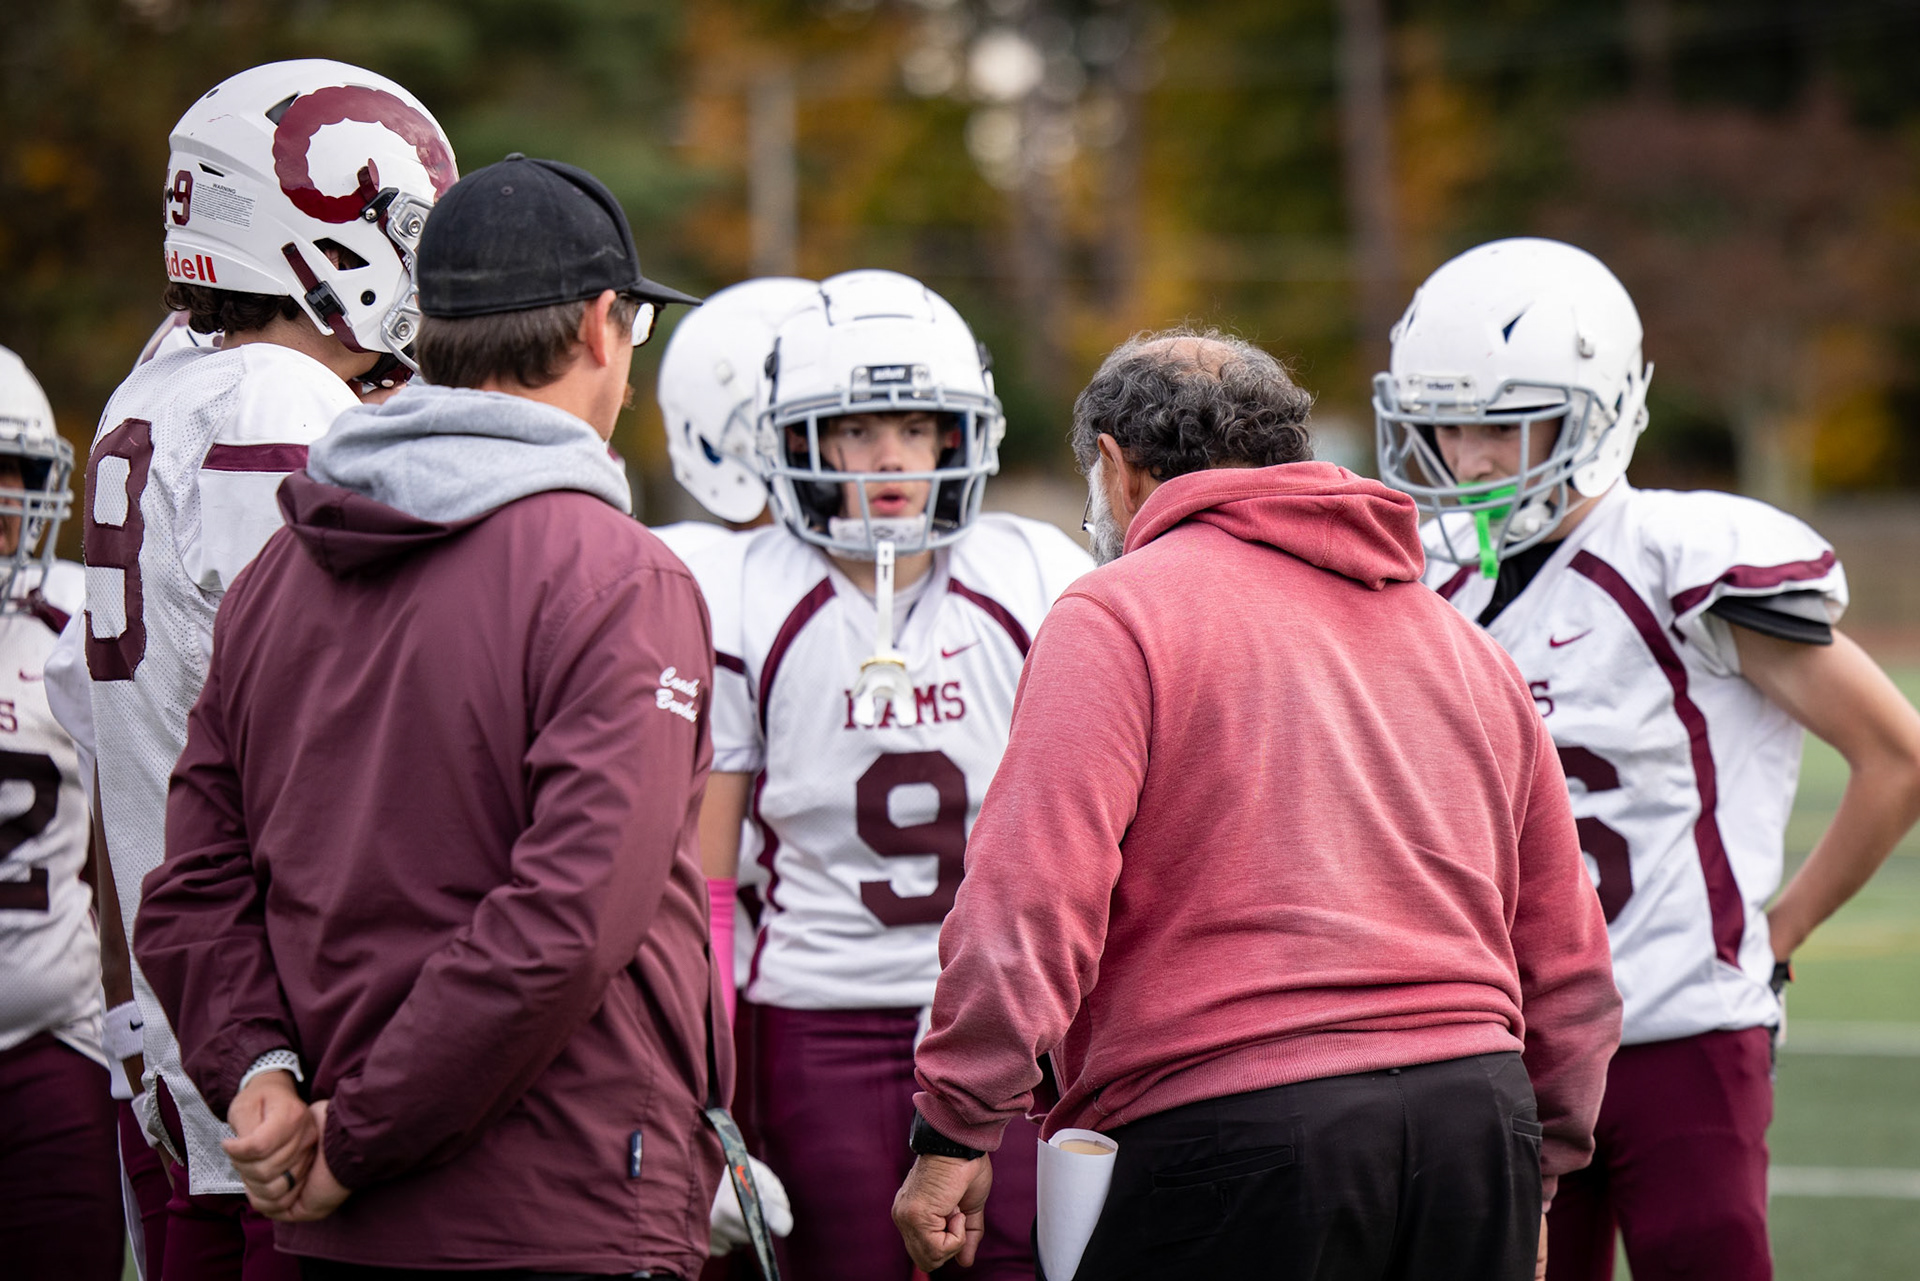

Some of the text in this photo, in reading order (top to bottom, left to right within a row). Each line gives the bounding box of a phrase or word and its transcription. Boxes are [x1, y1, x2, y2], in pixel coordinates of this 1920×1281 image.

[172, 170, 193, 226] 9
[212, 183, 236, 195] WARNING
[84, 418, 154, 682] 9
[844, 681, 966, 729] MS
[856, 751, 969, 927] 9
